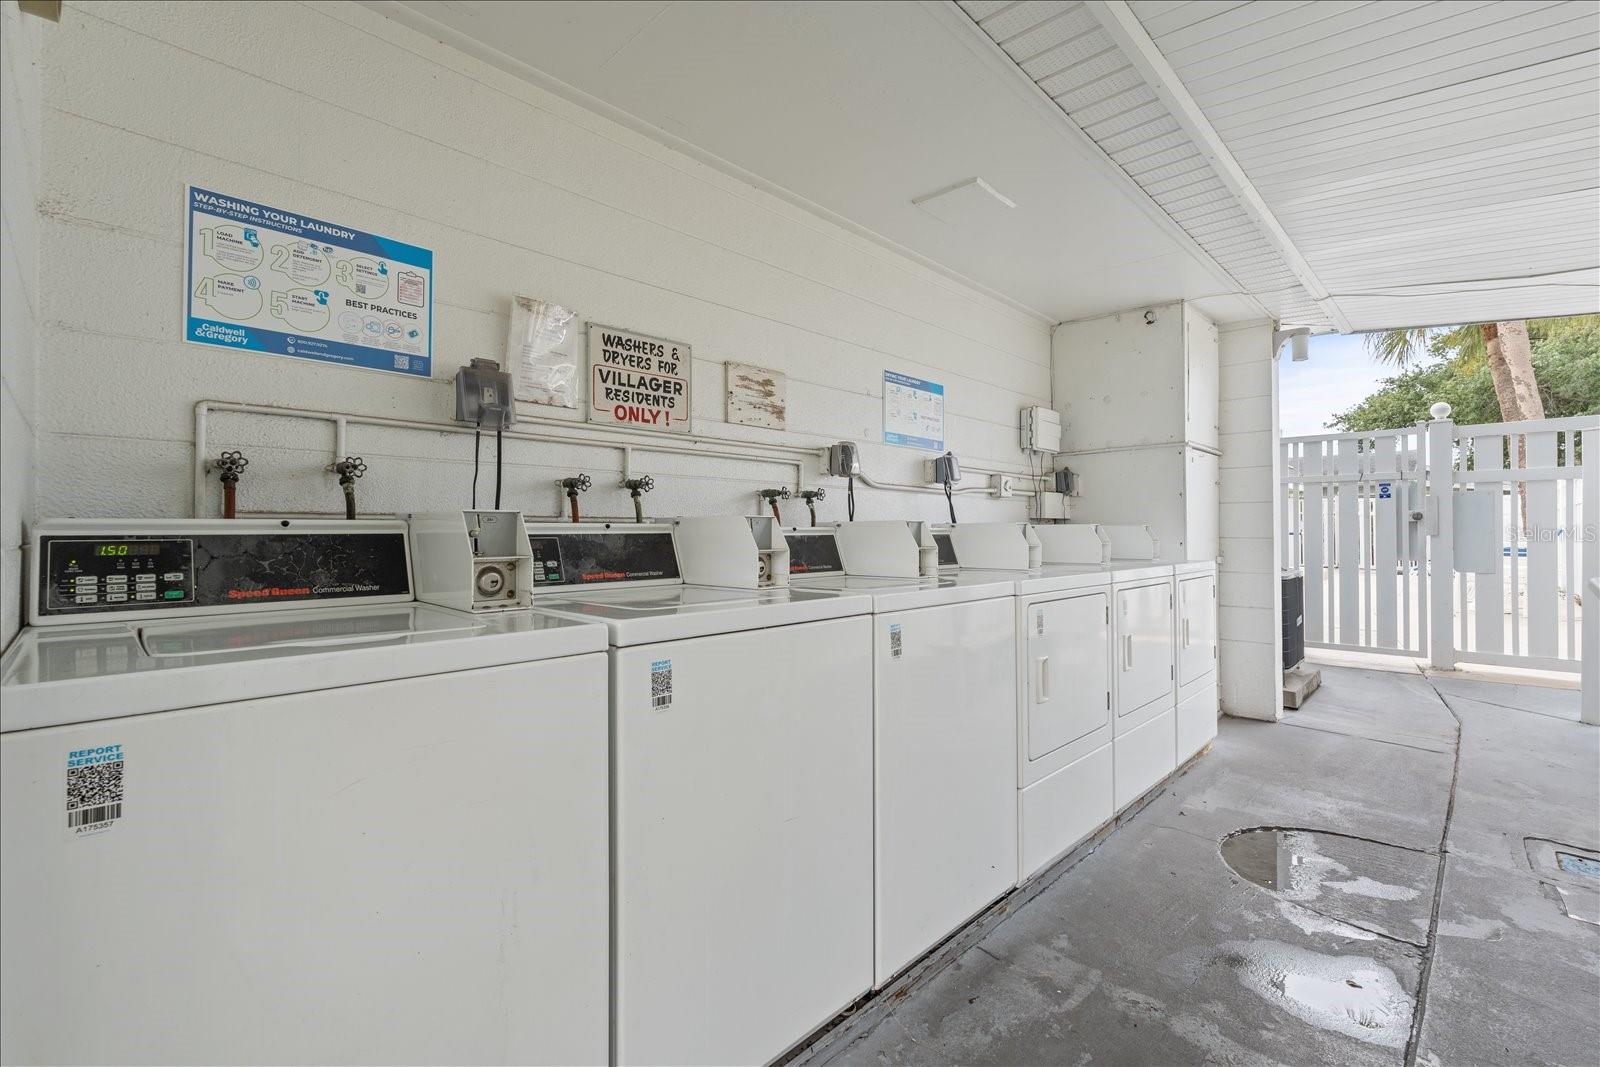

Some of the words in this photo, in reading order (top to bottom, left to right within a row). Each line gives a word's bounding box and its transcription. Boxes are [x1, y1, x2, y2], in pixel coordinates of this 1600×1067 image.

[194, 192, 259, 215] WASHING
[262, 210, 297, 226] YOUR
[300, 220, 356, 240] LAUNDRY
[194, 202, 248, 220] STEP-BY-STEP
[250, 216, 303, 233] INSTRUCTIONS
[216, 235, 243, 245] MACHINE
[218, 285, 244, 293] PAYMENT
[346, 299, 368, 309] BEST
[370, 305, 418, 320] PRACTICES
[202, 323, 245, 336] Caldwell
[602, 333, 664, 357] WASHERS
[672, 348, 680, 361] &
[602, 349, 651, 370] DRYERS
[658, 360, 678, 376] FOR
[598, 369, 683, 396] VILLAGER
[605, 387, 675, 408] RESIDENTS
[228, 588, 270, 599] Speed
[271, 587, 310, 596] Queen
[313, 584, 354, 594] Commercial
[68, 753, 124, 767] SERVICE
[69, 745, 122, 759] REPORT
[76, 821, 114, 833] A175357
